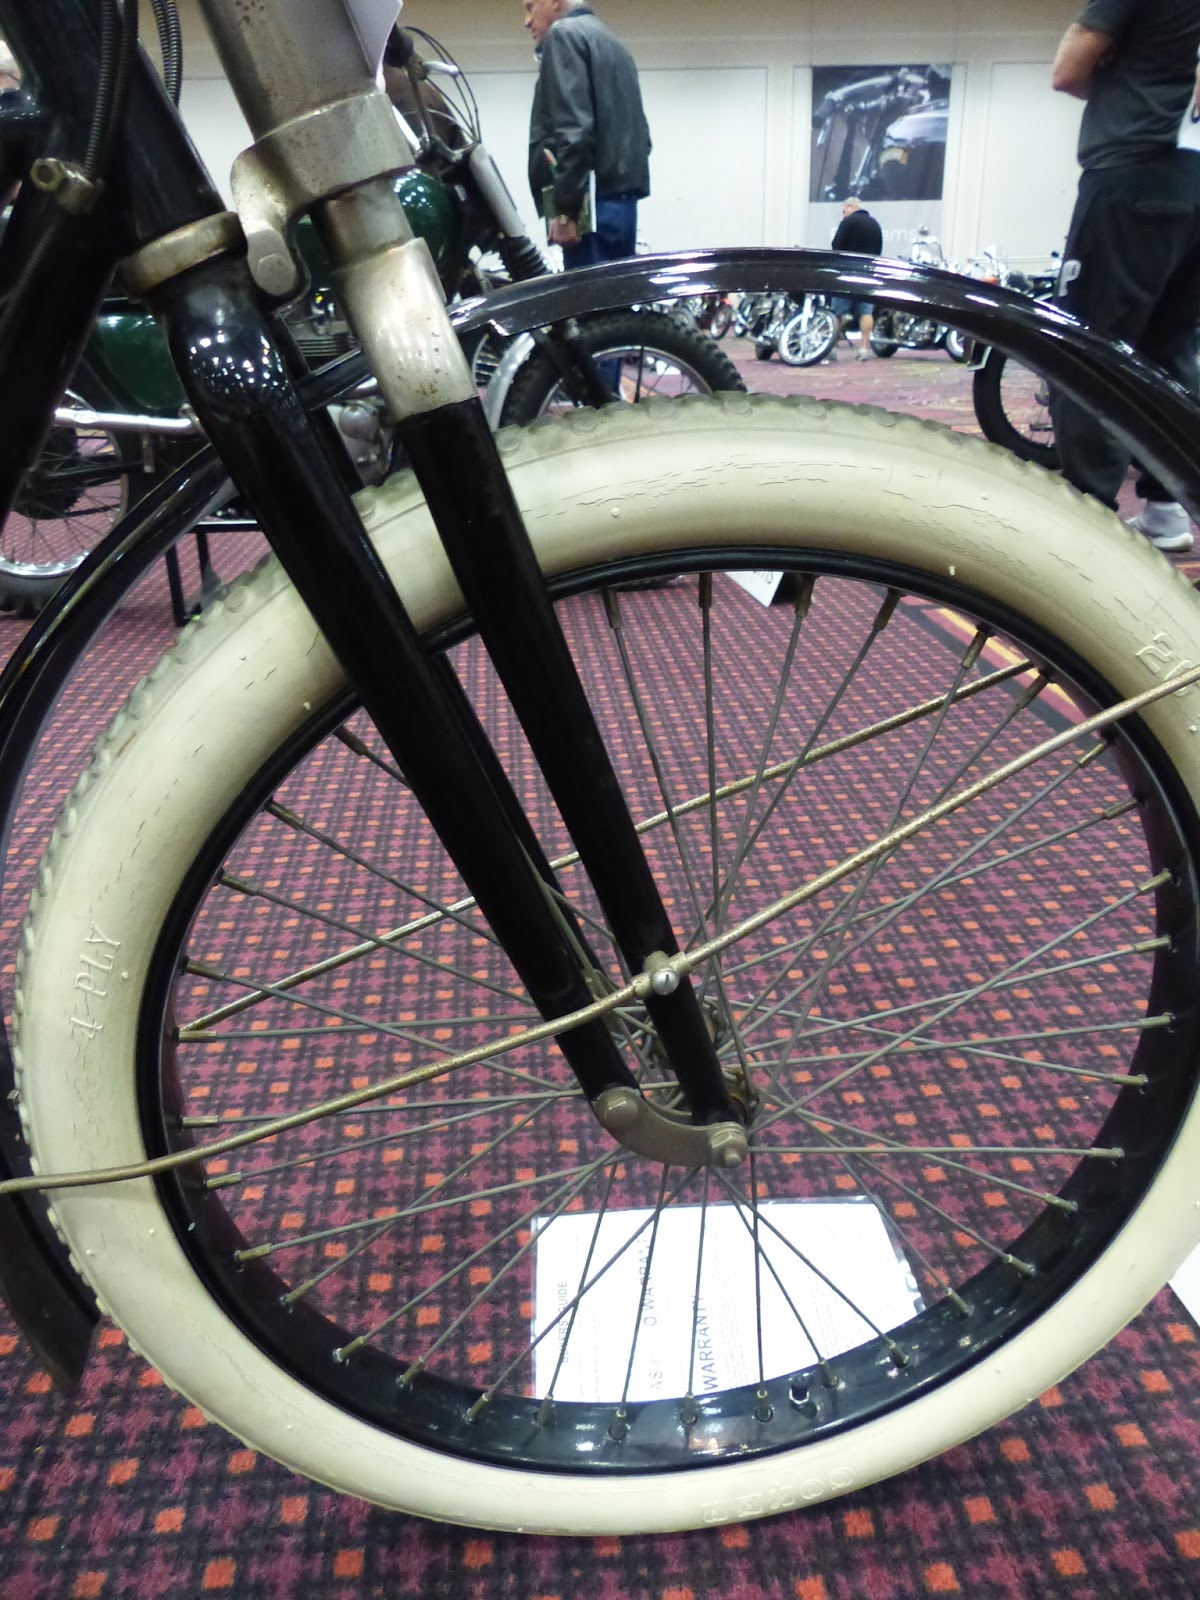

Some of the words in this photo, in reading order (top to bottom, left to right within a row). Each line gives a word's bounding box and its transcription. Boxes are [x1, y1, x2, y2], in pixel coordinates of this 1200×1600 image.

[73, 921, 121, 1000] PLY
[70, 1013, 104, 1039] 4
[691, 1295, 719, 1391] WARRANTY
